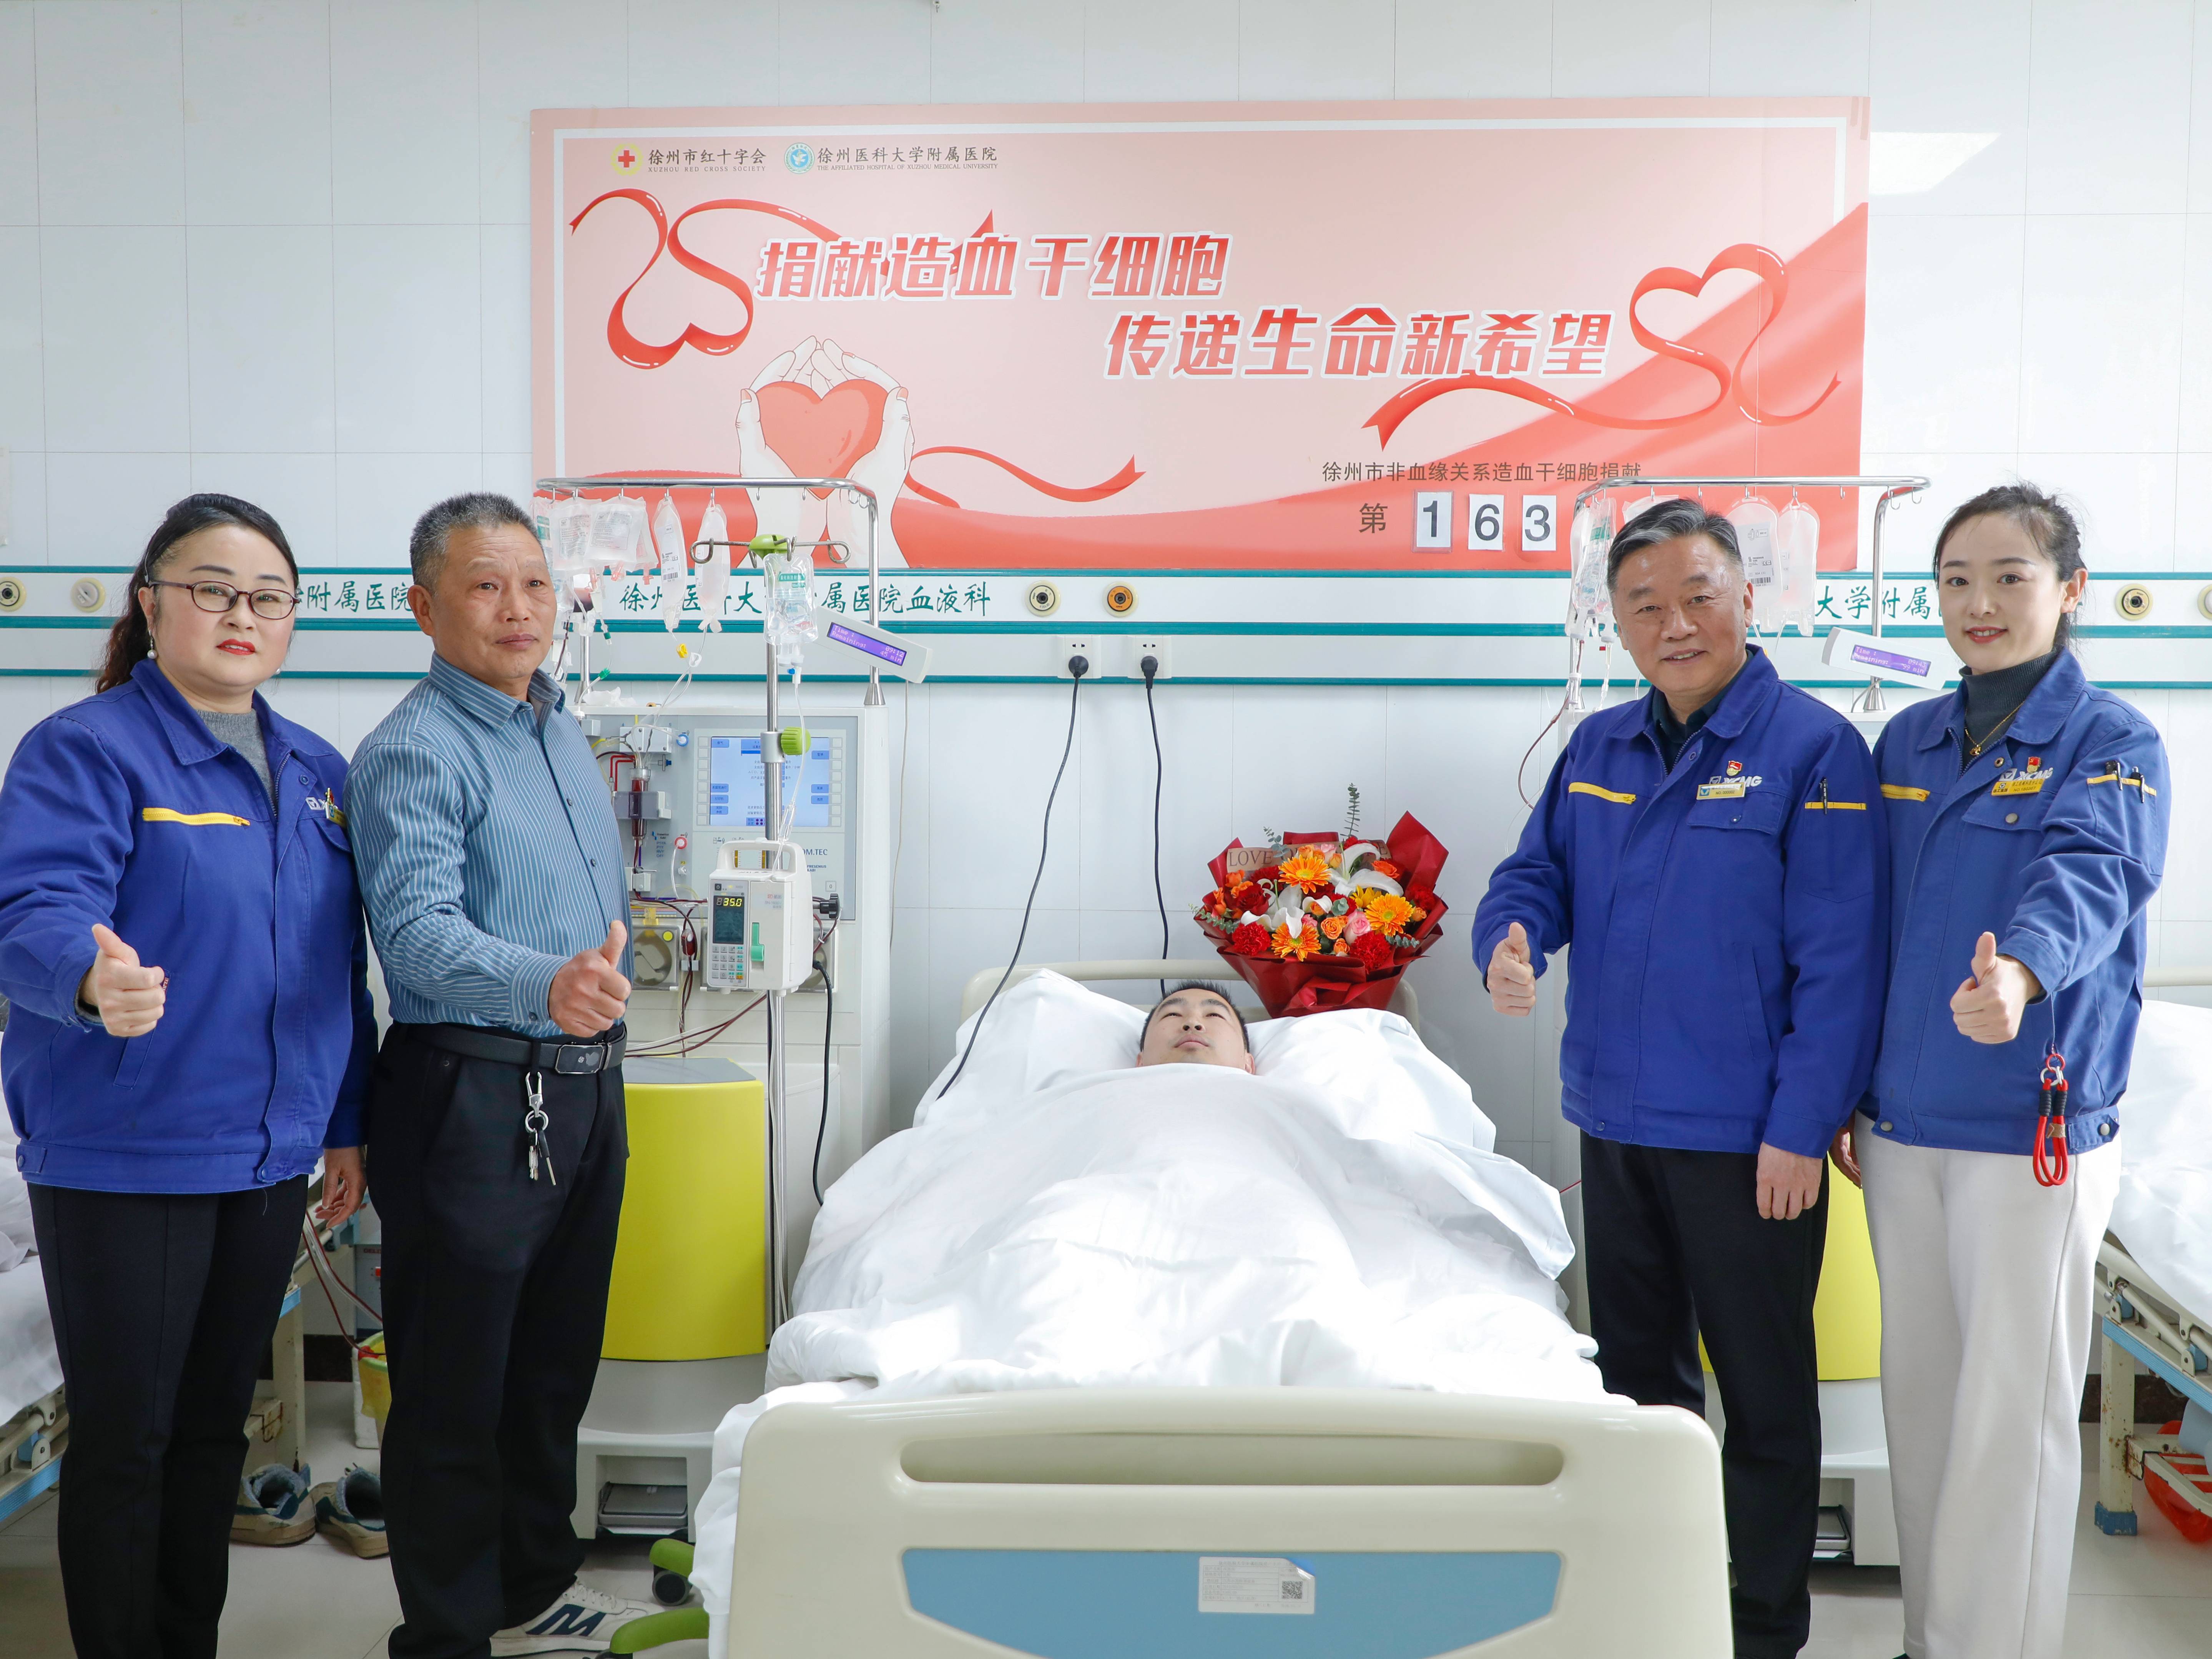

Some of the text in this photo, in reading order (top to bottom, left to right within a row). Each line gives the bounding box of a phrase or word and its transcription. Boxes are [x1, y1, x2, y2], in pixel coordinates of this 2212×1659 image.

[648, 148, 766, 165] 徐州市红十字会
[818, 146, 997, 163] 徐州医科大学附属医院
[756, 232, 1232, 299] 捐献造血干细胞
[1105, 306, 1613, 378] 传递生命新希望
[1322, 461, 1642, 482] 徐州市非血缘关系造血干细胞捐献
[1359, 503, 1388, 534] 第
[296, 581, 413, 612] 附属医院
[1815, 585, 1942, 620] 大学附属
[831, 631, 866, 648] Remaining:
[890, 655, 902, 663] min
[834, 625, 848, 635] Time
[885, 646, 904, 657] 09:12
[1856, 647, 1870, 655] Time
[1853, 653, 1889, 665] Remaining:
[2013, 768, 2053, 780] XCMG
[1229, 850, 1273, 866] LOVE
[723, 898, 743, 907] 35.0
